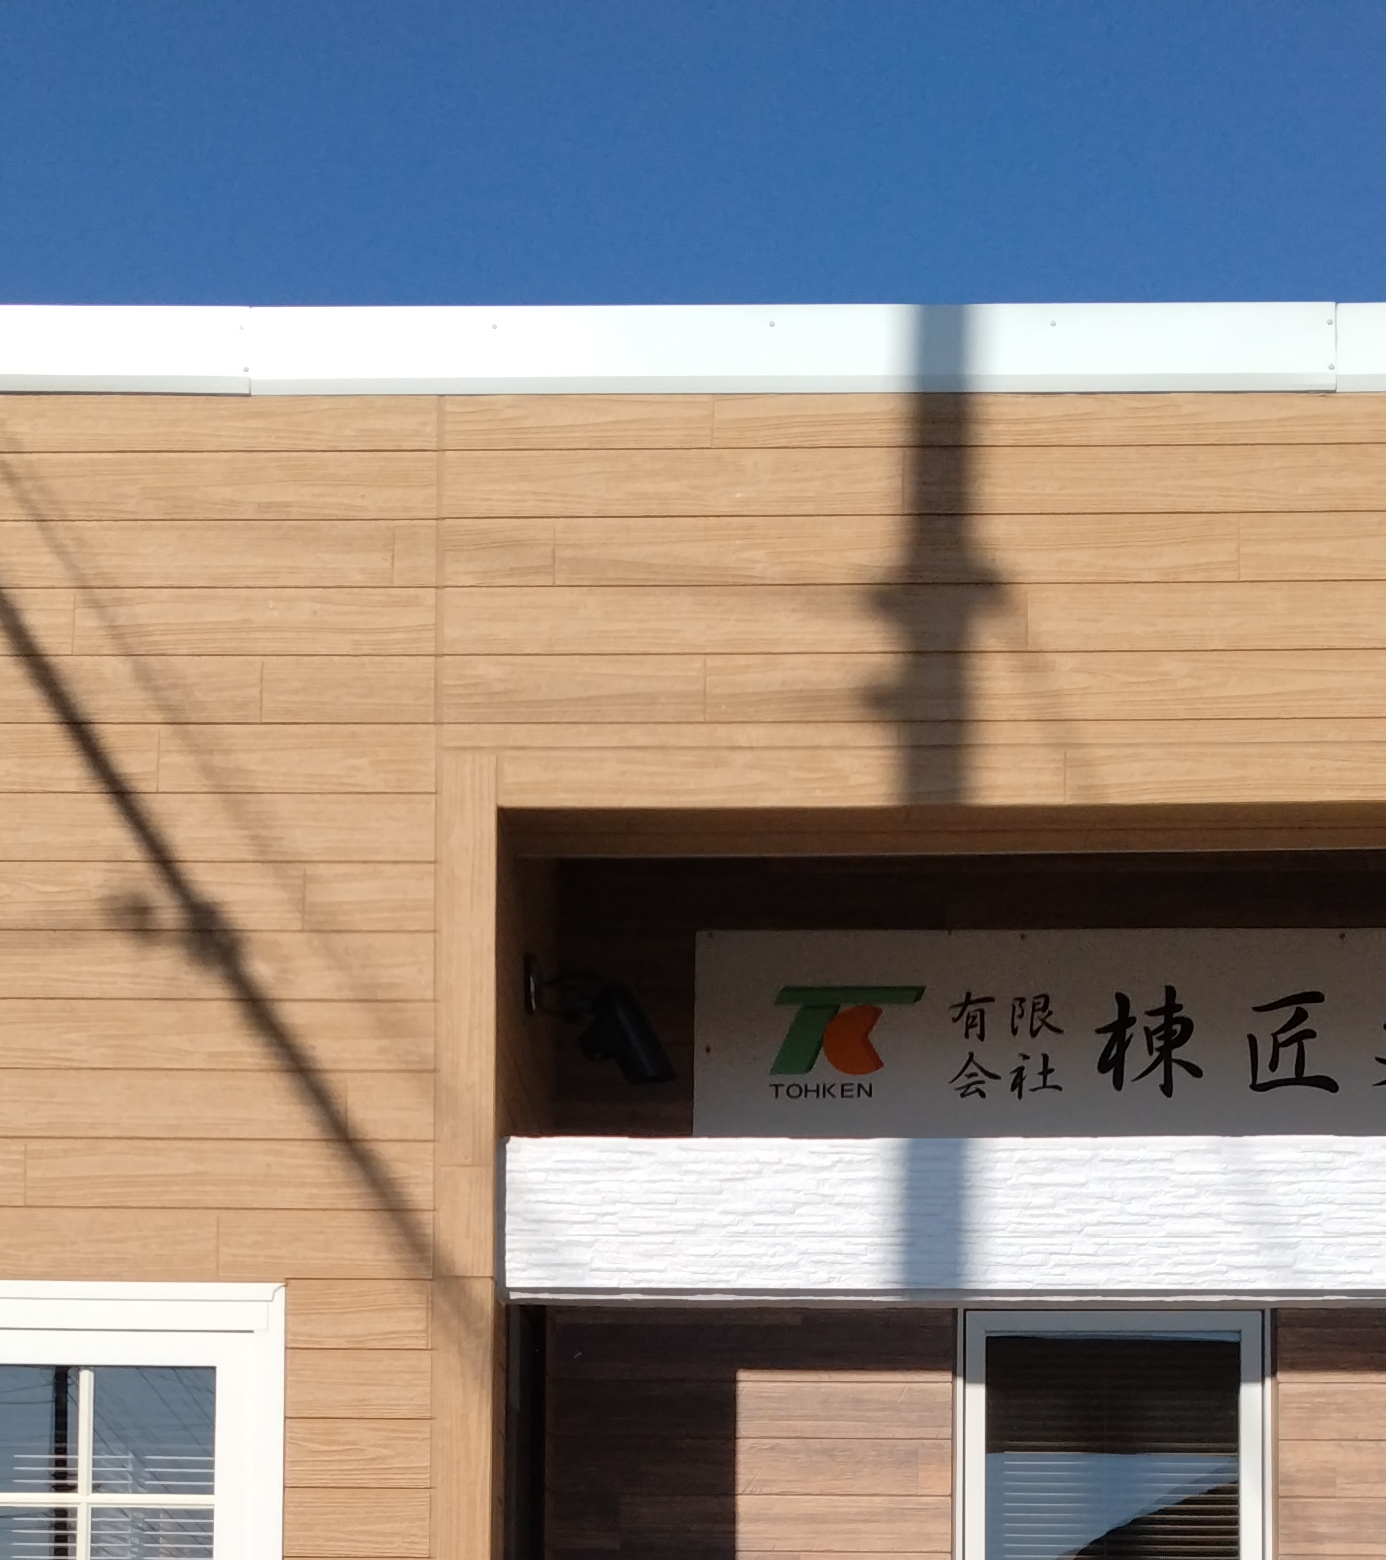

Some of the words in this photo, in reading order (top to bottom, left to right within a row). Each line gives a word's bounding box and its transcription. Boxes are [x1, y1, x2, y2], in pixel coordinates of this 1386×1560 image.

[948, 991, 1065, 1043] 有限
[768, 1082, 873, 1099] TOHKEN
[948, 1051, 1063, 1101] 会社
